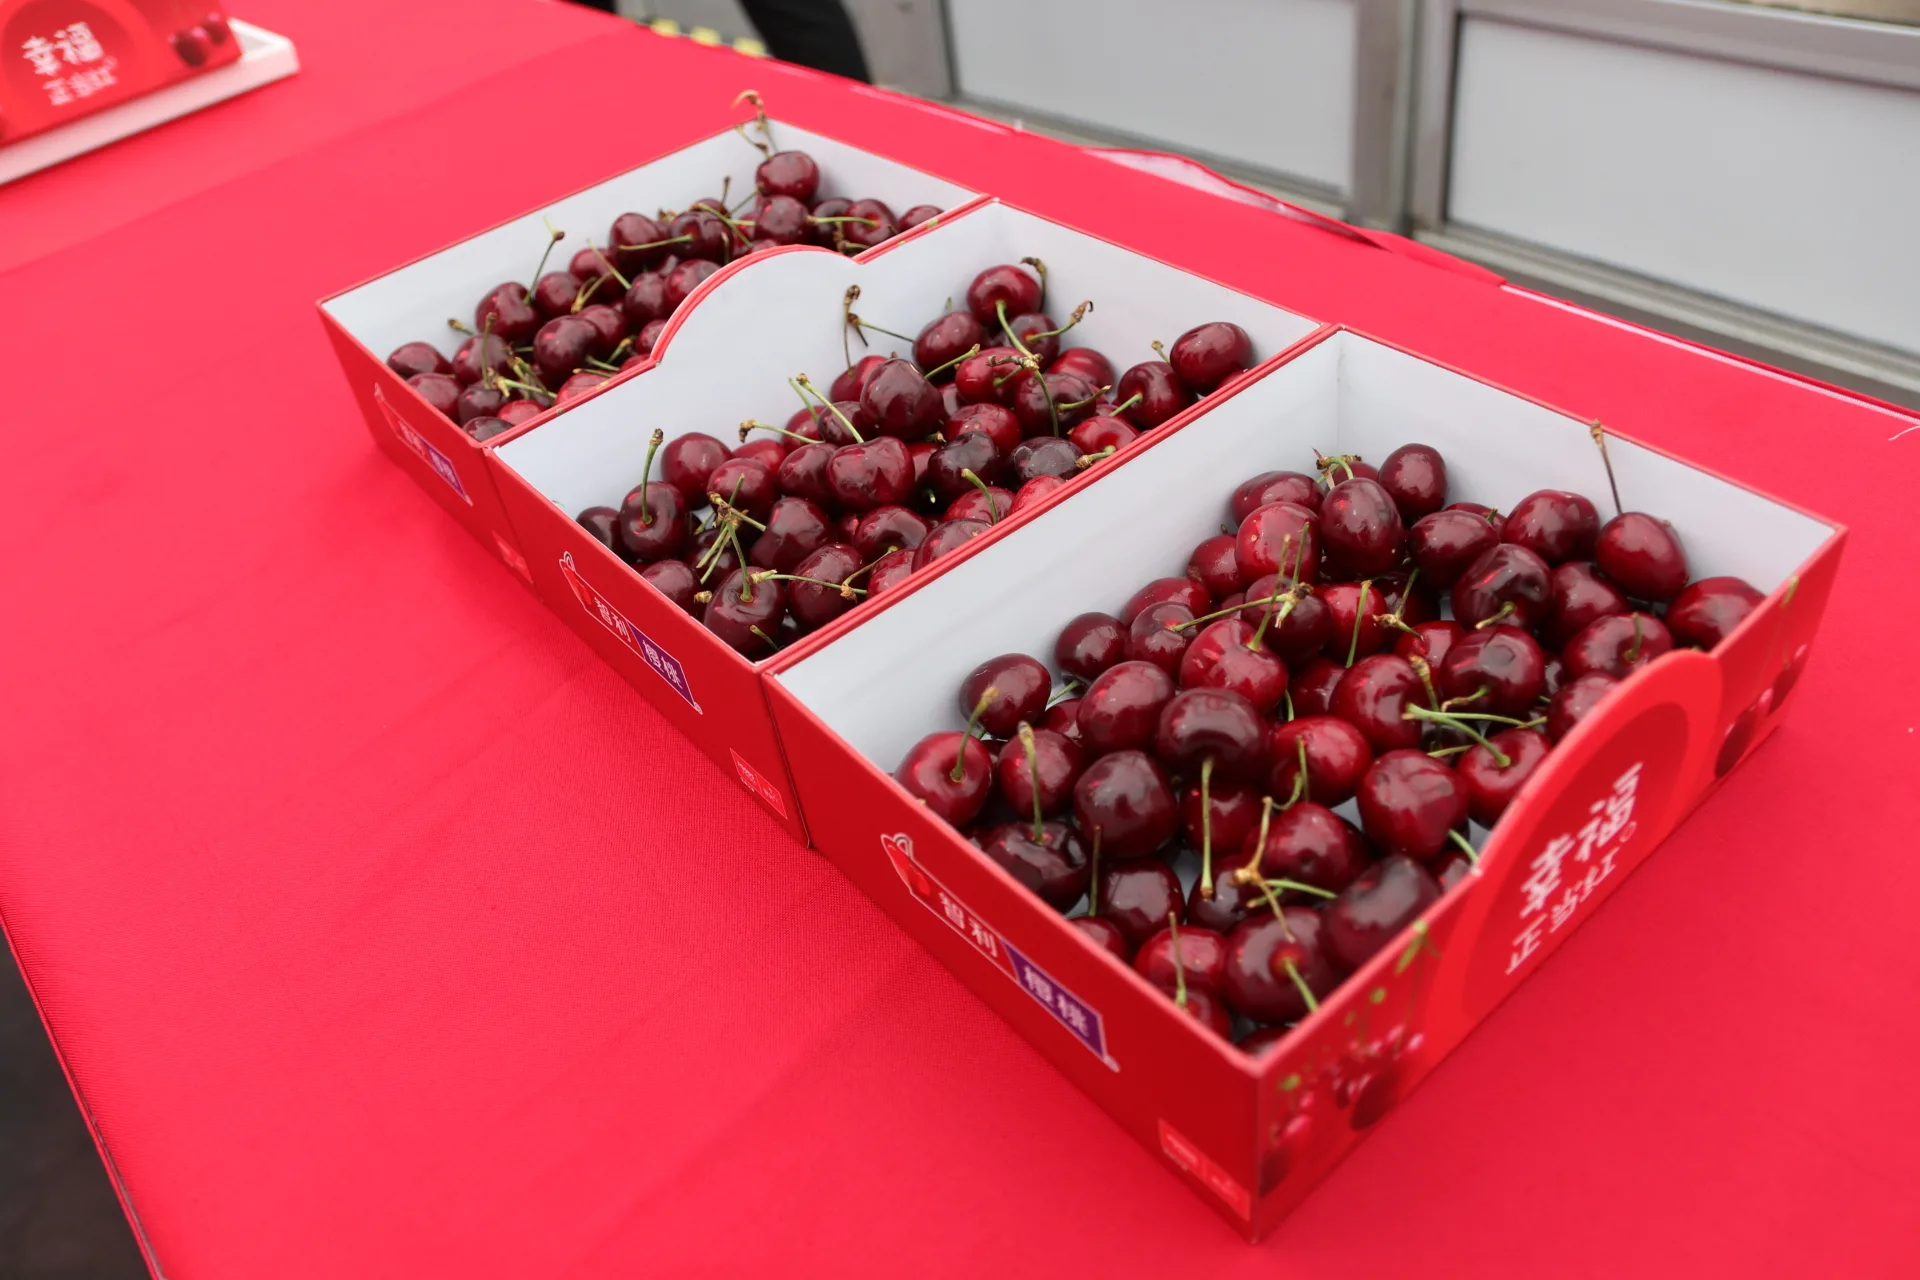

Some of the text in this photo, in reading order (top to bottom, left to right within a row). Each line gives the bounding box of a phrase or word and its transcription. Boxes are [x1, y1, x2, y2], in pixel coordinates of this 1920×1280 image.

[21, 21, 104, 77] 幸福
[594, 596, 632, 643] 智利
[1519, 761, 1644, 919] 幸福
[938, 891, 999, 959] 智利
